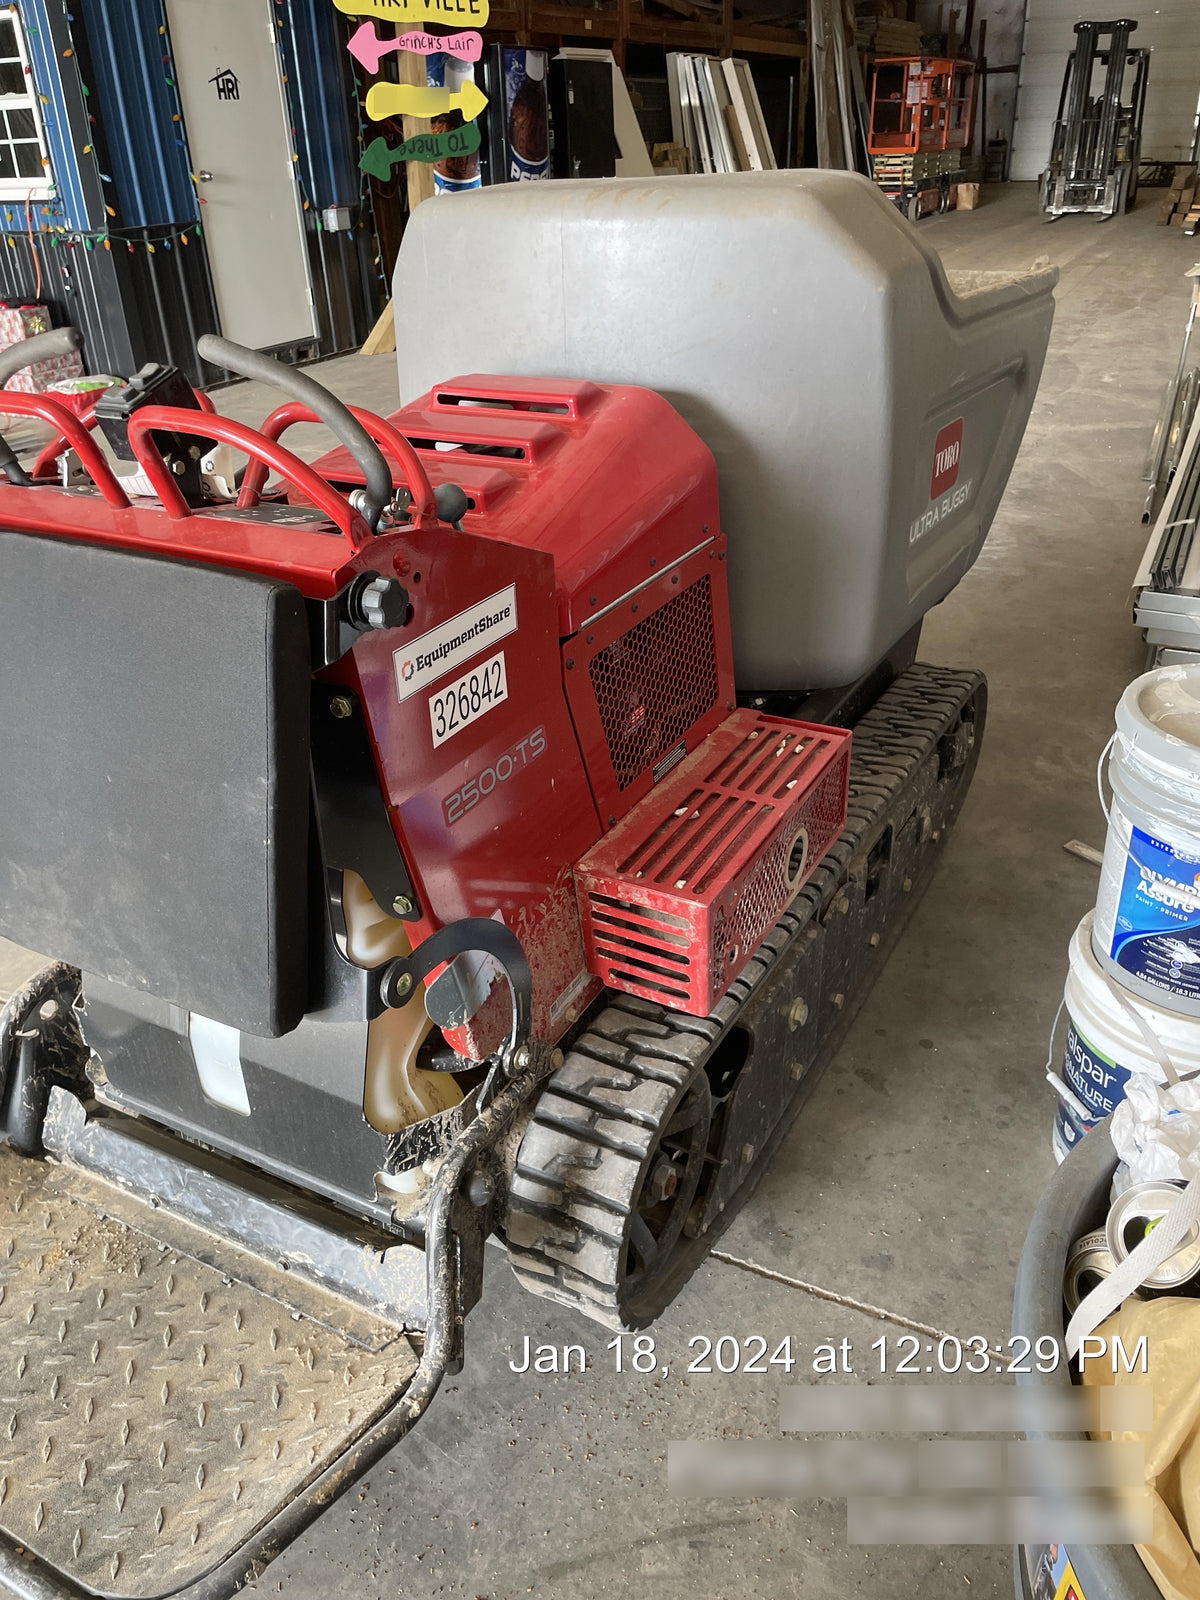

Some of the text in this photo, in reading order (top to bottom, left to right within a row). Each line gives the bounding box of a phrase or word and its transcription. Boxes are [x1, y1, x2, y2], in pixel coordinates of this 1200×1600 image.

[448, 37, 475, 50] Lair
[397, 138, 443, 158] There
[934, 440, 960, 478] TORO
[909, 478, 972, 543] ULTRA BUGGY
[415, 605, 511, 672] EquipmentShare
[433, 660, 505, 738] 326842
[1160, 906, 1189, 922] PRIMER
[1079, 1237, 1107, 1249] COLATE
